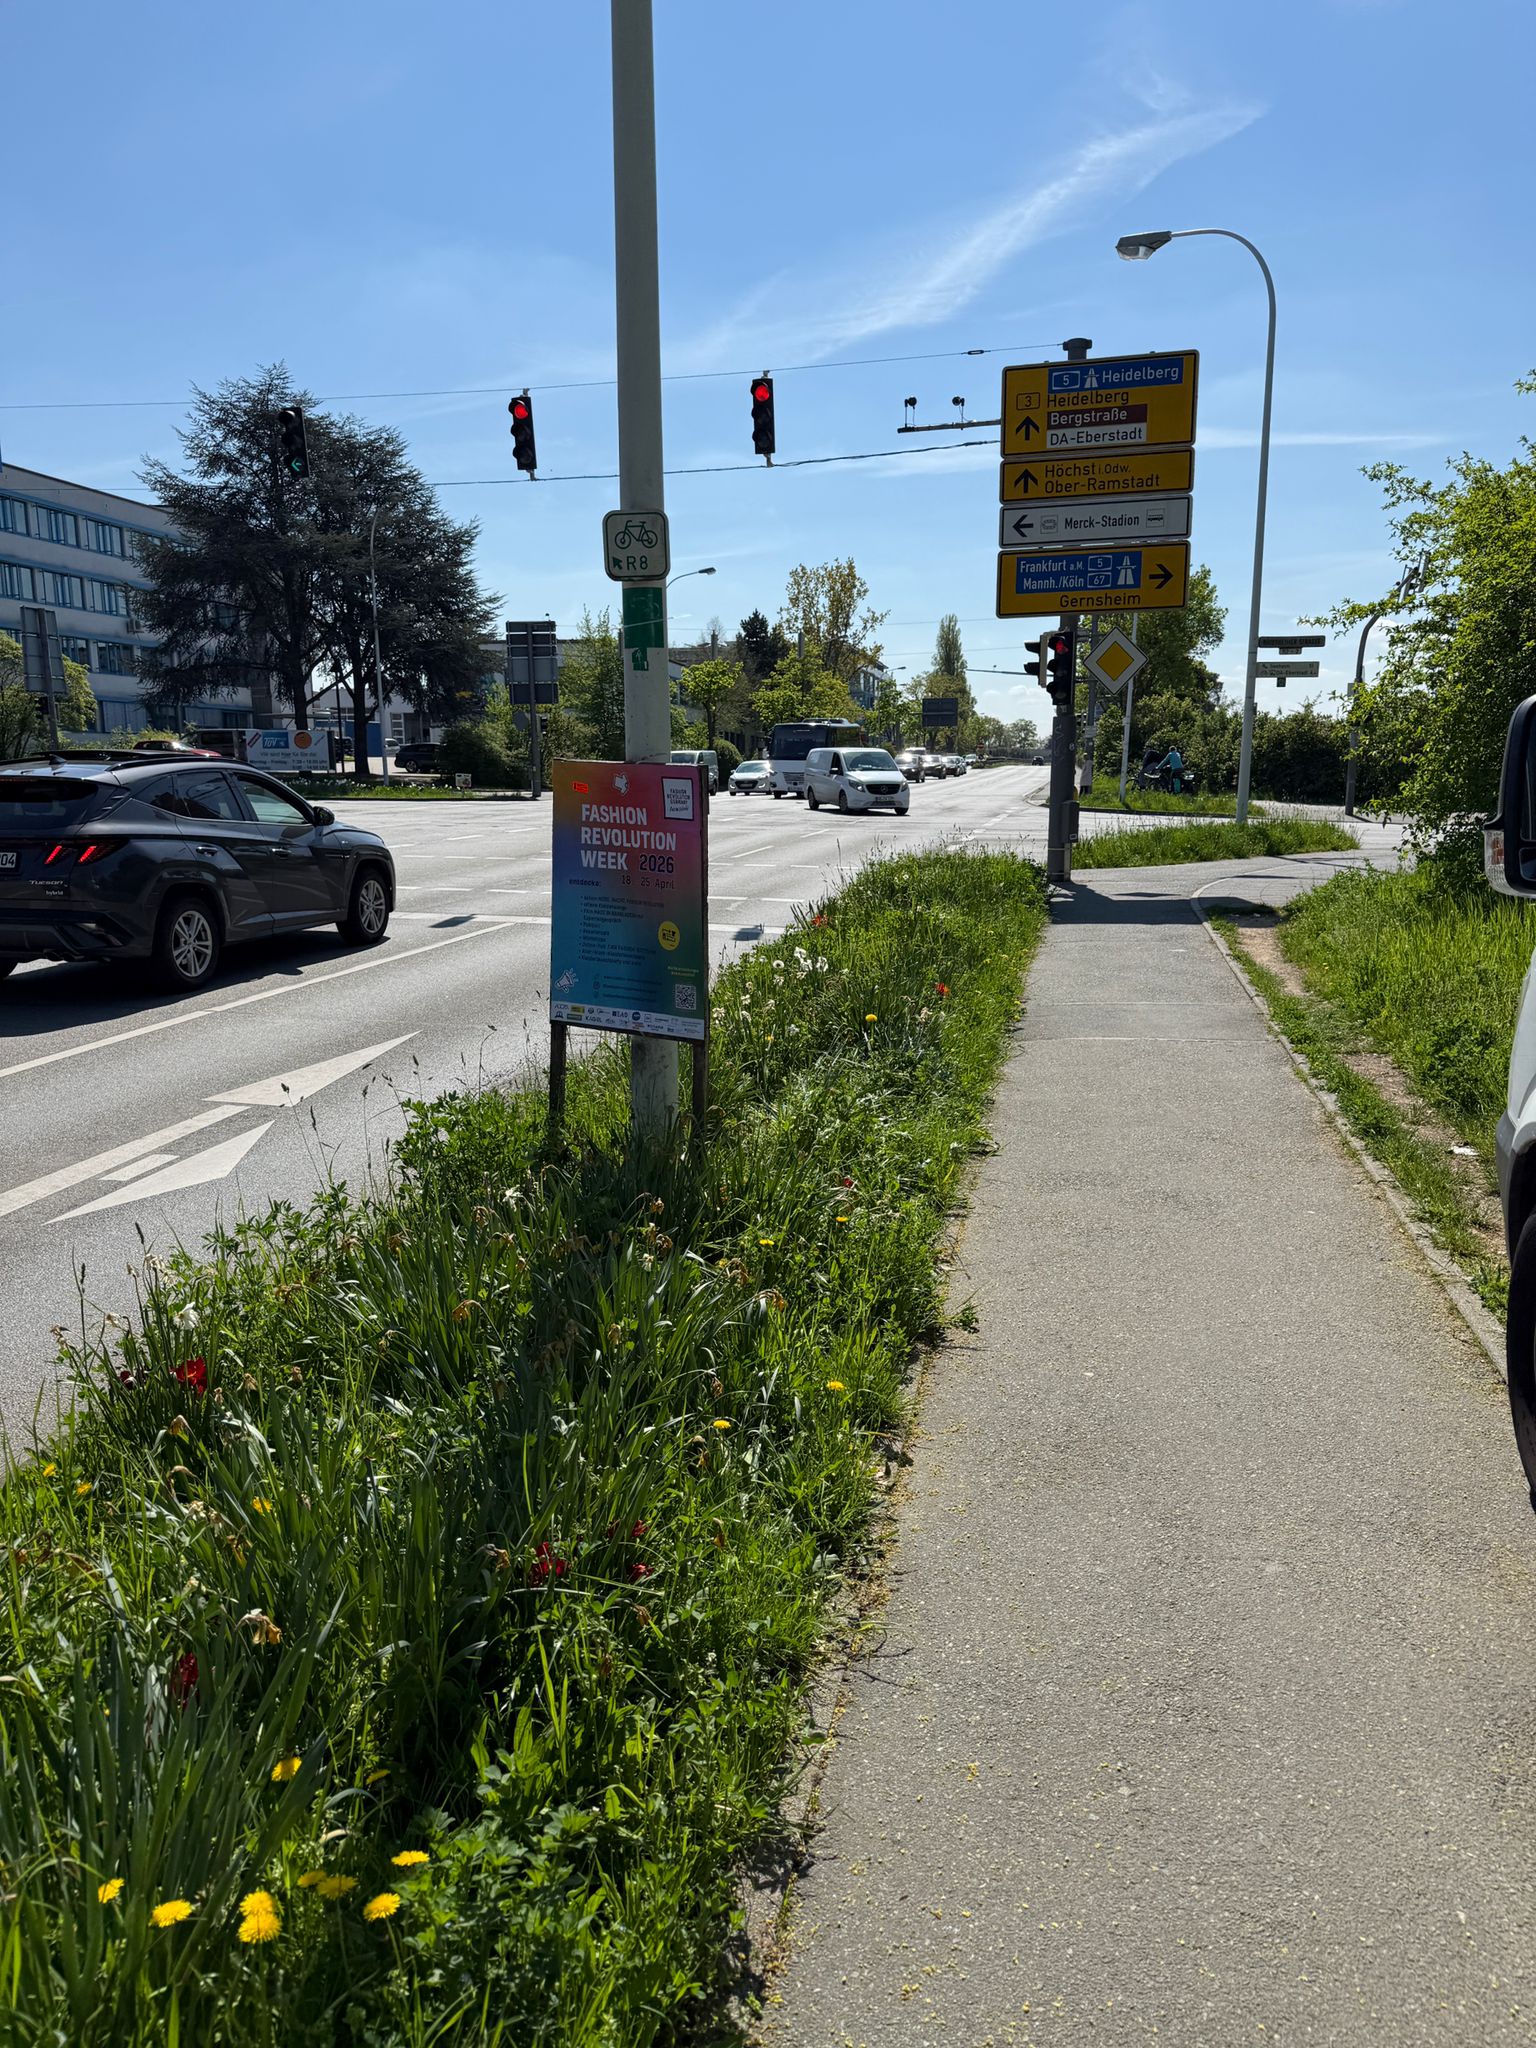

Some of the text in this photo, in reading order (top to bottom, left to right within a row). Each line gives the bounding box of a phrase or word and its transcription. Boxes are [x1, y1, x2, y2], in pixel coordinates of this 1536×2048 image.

[1062, 365, 1179, 386] 5 Heidelberg
[1024, 395, 1033, 408] 3
[1047, 390, 1130, 408] Heidelberg
[1050, 408, 1128, 426] Bergstraße
[1050, 427, 1143, 446] DA-Eberstadt
[1045, 462, 1096, 478] Höchst
[1044, 474, 1160, 494] Ober-Ramstadt
[1064, 513, 1140, 530] Merck-Stadion
[1020, 559, 1084, 574] Frankfurt a.M.
[1096, 558, 1103, 568] 5
[1023, 575, 1084, 590] Mannh./Köln
[1093, 574, 1105, 585] 67
[1059, 593, 1141, 609] Gernsheim
[581, 803, 647, 826] FASHION
[580, 826, 676, 851] REVOLUTION
[580, 850, 674, 874] WEEK 2026
[654, 878, 675, 891] April
